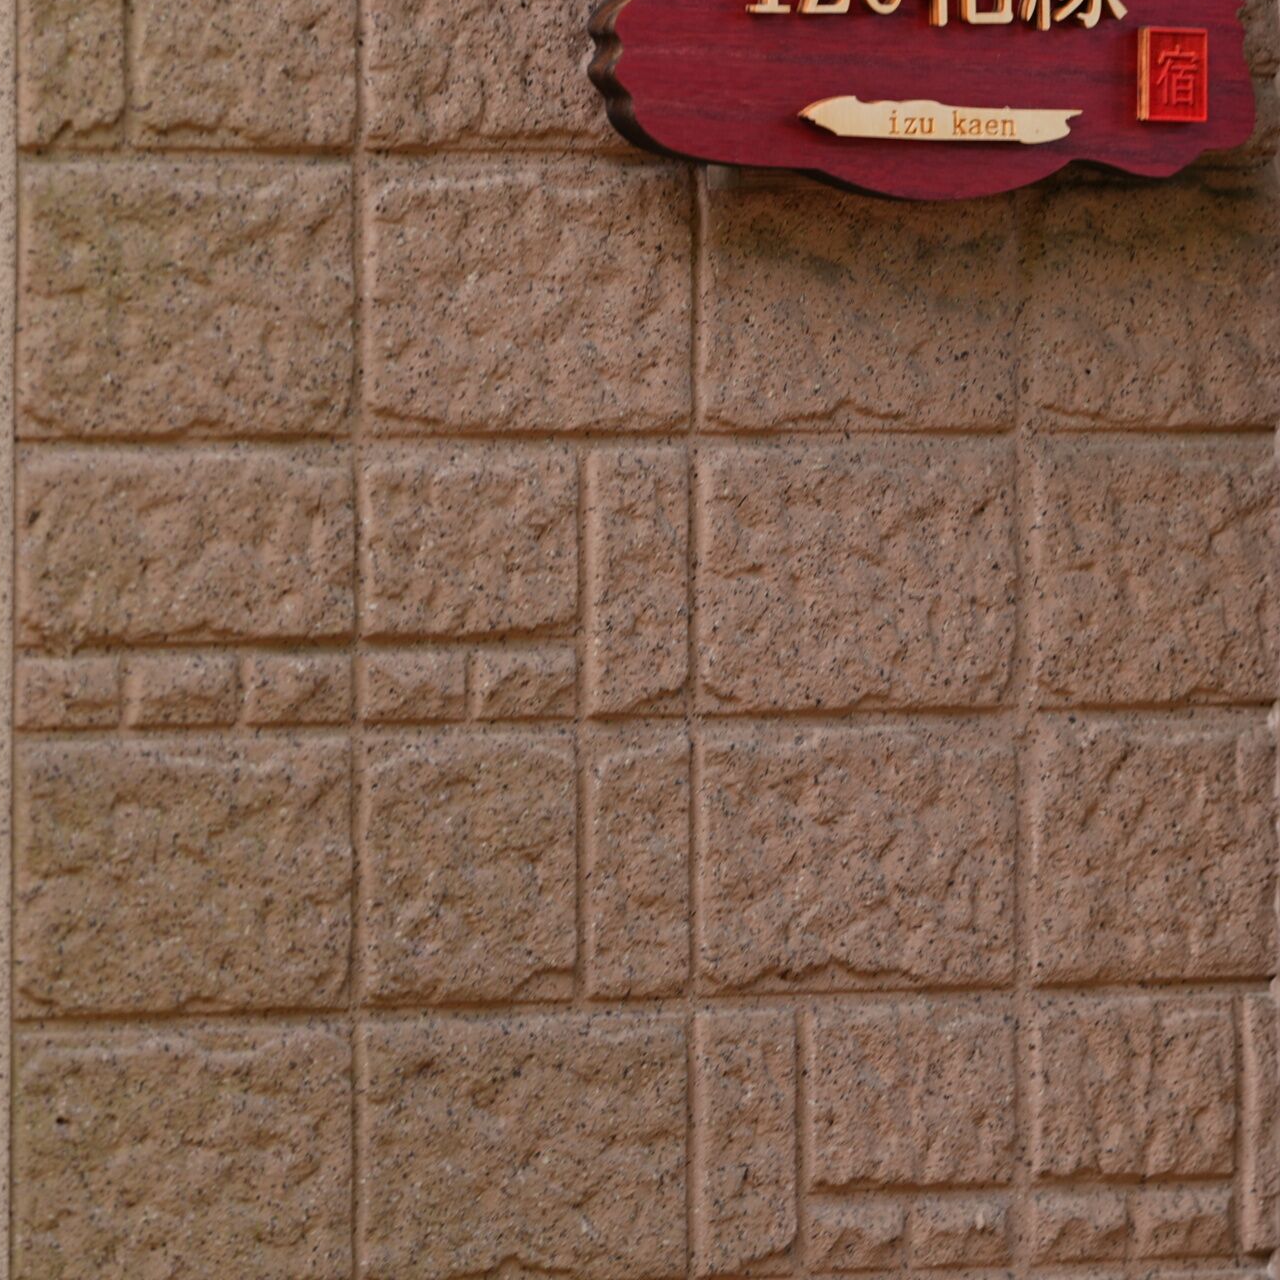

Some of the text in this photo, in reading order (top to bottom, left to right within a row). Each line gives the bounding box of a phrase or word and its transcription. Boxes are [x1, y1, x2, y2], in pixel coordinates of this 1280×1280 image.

[1156, 44, 1199, 105] 宿
[889, 110, 1017, 136] izu kaen
